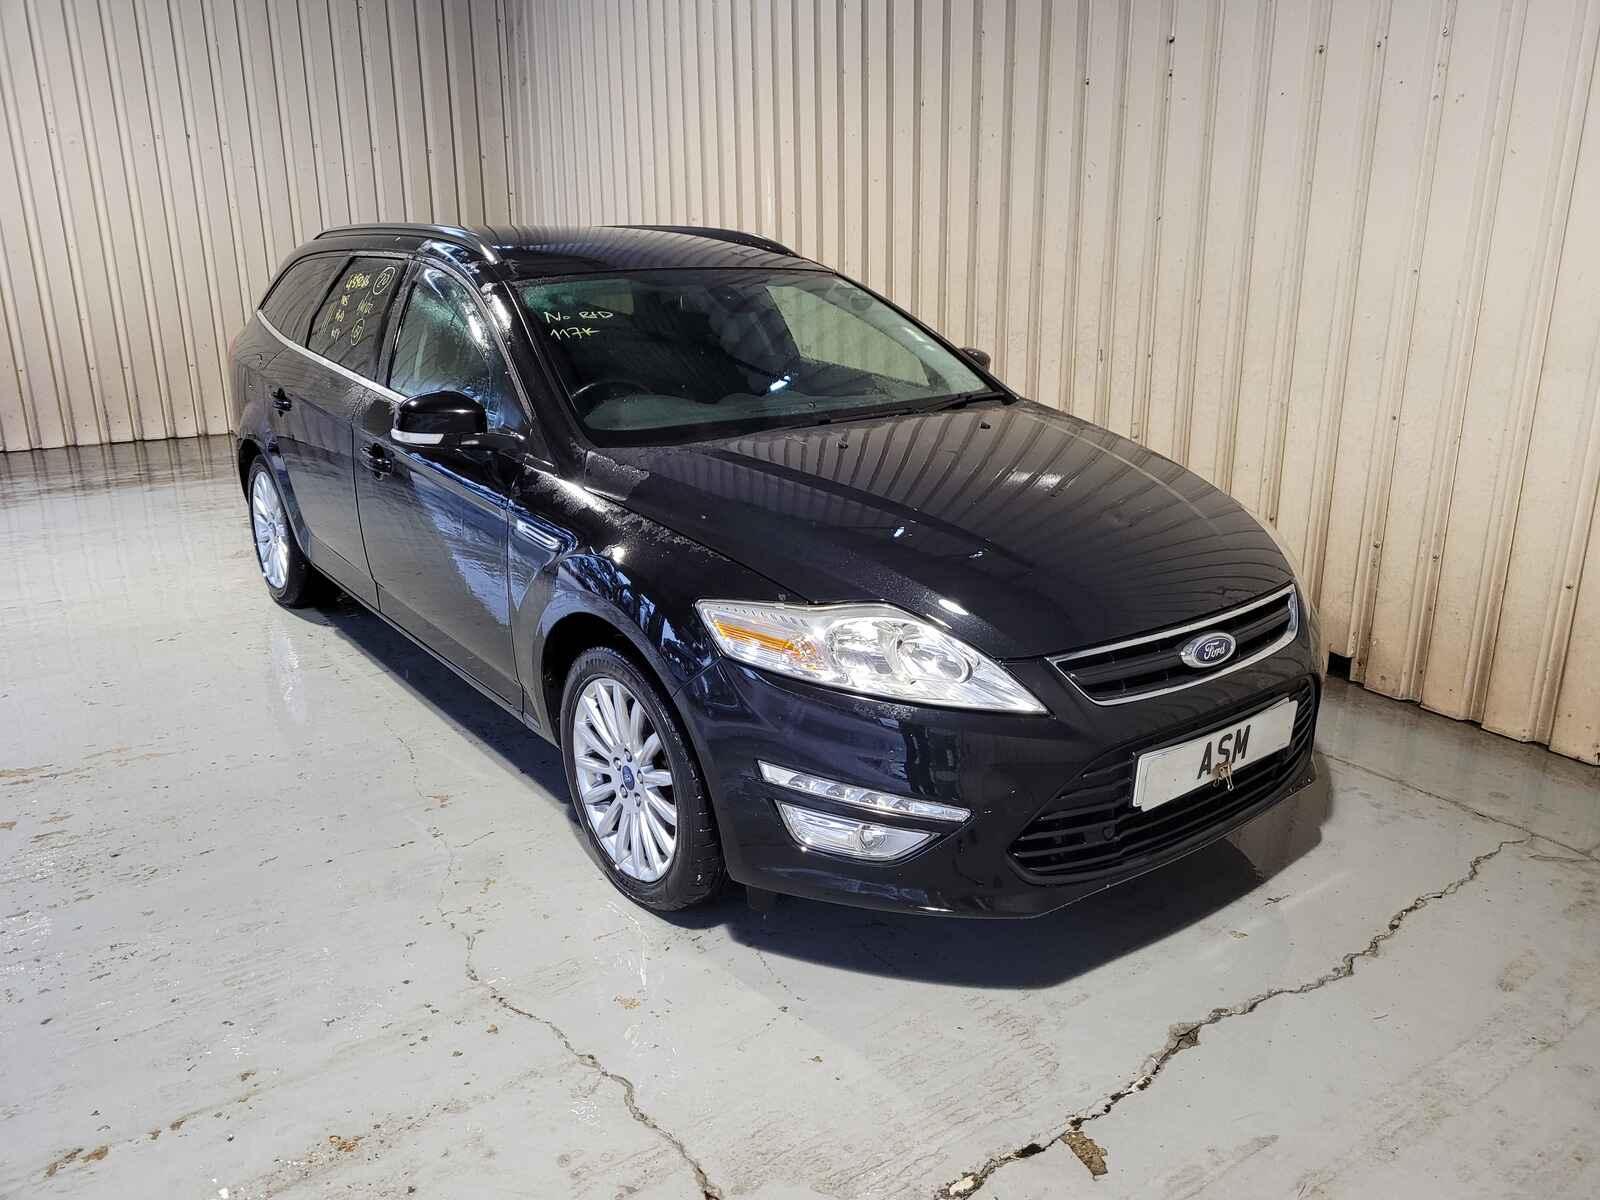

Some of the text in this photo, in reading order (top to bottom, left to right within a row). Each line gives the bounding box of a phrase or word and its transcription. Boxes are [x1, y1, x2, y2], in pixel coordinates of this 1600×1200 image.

[544, 311, 571, 323] No
[1204, 641, 1226, 660] Ford
[1197, 724, 1251, 780] ASM
